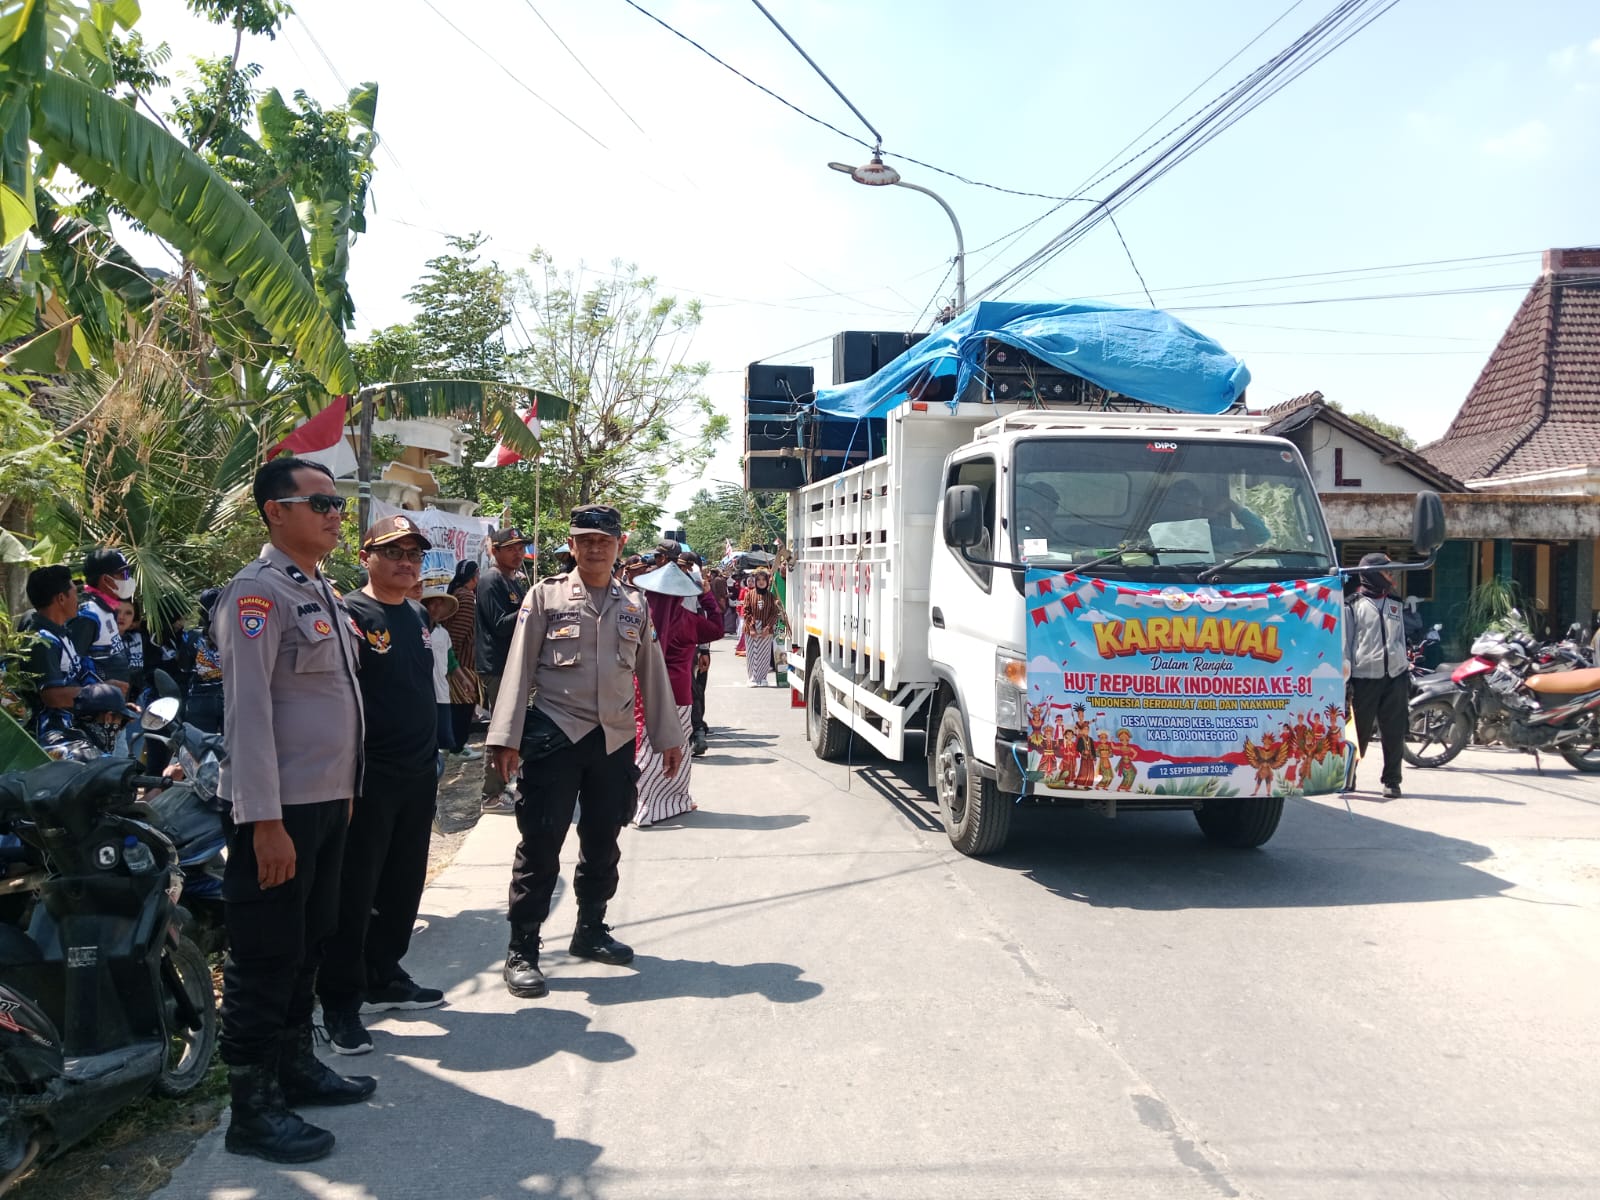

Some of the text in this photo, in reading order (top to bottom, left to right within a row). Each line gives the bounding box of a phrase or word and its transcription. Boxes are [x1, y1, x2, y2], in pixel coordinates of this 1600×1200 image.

[1093, 617, 1283, 663] KARNAVAL
[1150, 656, 1234, 675] Dalam Rangka
[1063, 672, 1313, 695] HUT REPUBLIK INDONESIA KE-81
[1143, 699, 1195, 710] BERDAULAT
[1197, 699, 1217, 710] ADIL
[1219, 699, 1238, 710] DAN
[1121, 715, 1258, 728] DESA WADANG KEC. NGASEM
[1147, 730, 1238, 741] KAB. BOJONEGORO
[1159, 765, 1229, 776] 12 SEPTEMBER 2026
